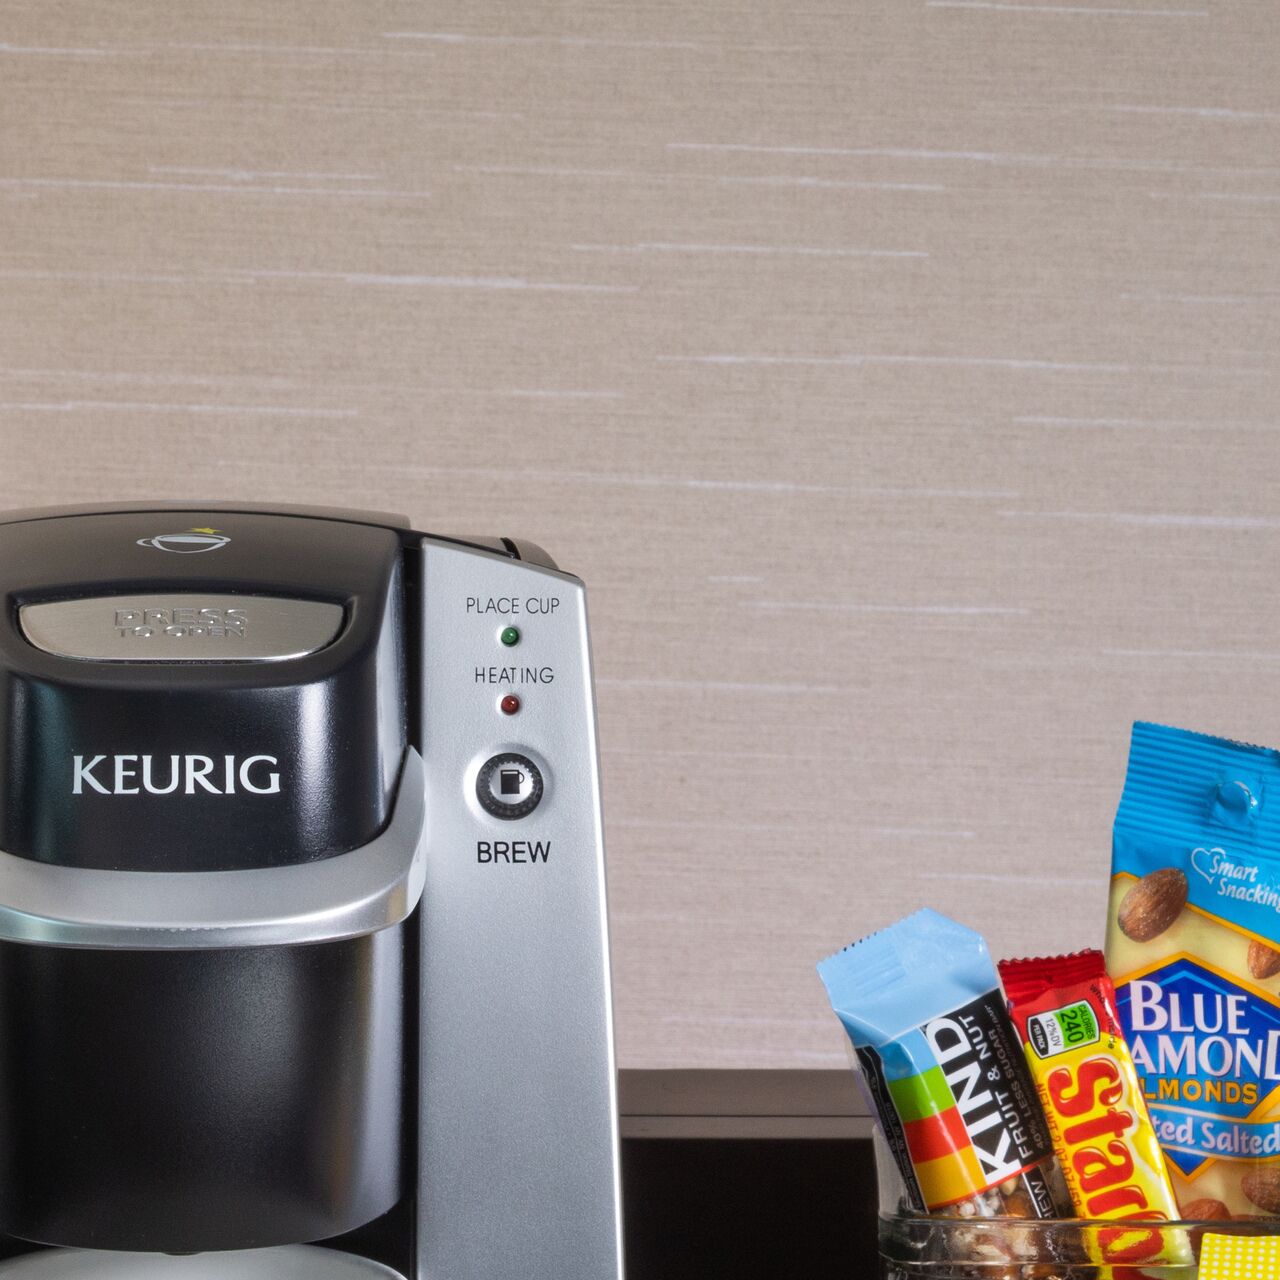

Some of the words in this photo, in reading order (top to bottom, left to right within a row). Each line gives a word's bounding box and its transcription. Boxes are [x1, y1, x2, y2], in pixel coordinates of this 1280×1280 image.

[114, 607, 249, 627] PRESS
[466, 597, 519, 614] PLACE
[525, 597, 560, 614] CUP
[114, 625, 153, 638] TO
[164, 625, 246, 639] OPEN
[474, 667, 555, 683] HEATING
[72, 754, 281, 795] KEURIG
[477, 841, 551, 863] BREW
[1210, 854, 1258, 883] Smart
[1077, 1003, 1096, 1041] CALORIES
[1129, 979, 1250, 1036] BLUE
[958, 1014, 992, 1061] NUT
[1061, 1009, 1085, 1043] 240
[987, 1026, 1016, 1081] SUGAR
[1036, 1034, 1047, 1050] PACK
[987, 1064, 1001, 1081] &
[924, 1017, 1022, 1186] KIND
[1140, 1079, 1258, 1105] LMONDS
[995, 1090, 1033, 1160] FRUIT
